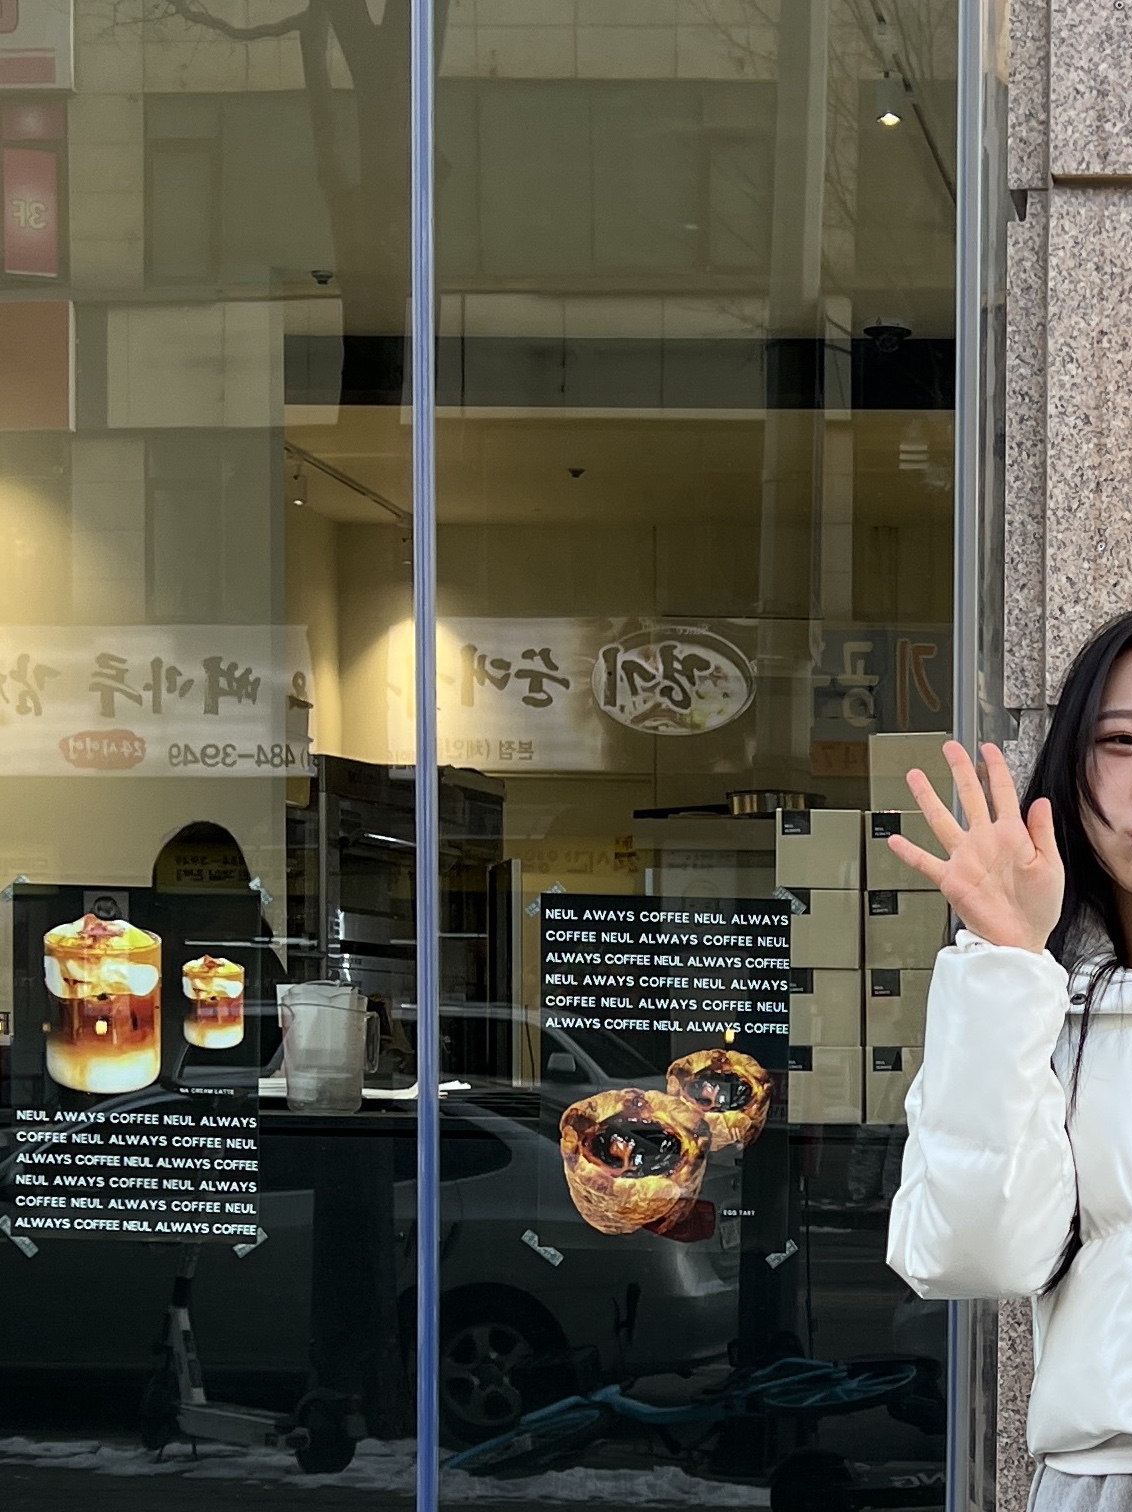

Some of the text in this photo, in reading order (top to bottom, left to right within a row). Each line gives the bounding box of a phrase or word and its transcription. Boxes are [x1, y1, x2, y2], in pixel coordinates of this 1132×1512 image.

[545, 908, 788, 925] NEUL AWAYS COFFEE NEUL ALWAYS
[545, 930, 789, 947] COFFEE NEUL ALWAYS COFFEE NEUL
[545, 952, 789, 969] ALWAYS COFFEE NEUL ALWAYS COFFEE
[545, 973, 578, 985] NEUL
[582, 974, 634, 986] AWAYS
[639, 976, 689, 988] COFFEE
[693, 977, 725, 989] NEUL
[730, 978, 787, 990] ALWAYS
[545, 995, 789, 1012] COFFEE NEUL ALWAYS COFFEE NEUL
[545, 1016, 789, 1035] ALWAYS COFFEE NEUL ALWAYS COFFEE
[16, 1109, 257, 1128] NEUL AWAYS COFFEE NEUL ALWAYS
[16, 1131, 257, 1149] COFFEE NEUL ALWAYS COFFEE NEUL
[15, 1151, 258, 1171] ALWAYS COFFEE NEUL ALWAYS COFFEE
[15, 1174, 257, 1192] NEUL AWAYS COFFEE NEUL ALWAYS
[15, 1195, 256, 1214] COFFEE NEUL ALWAYS COFFEE NEUL
[14, 1217, 257, 1236] ALWAYS COFFEE NEUL ALWAYS COFFEE
